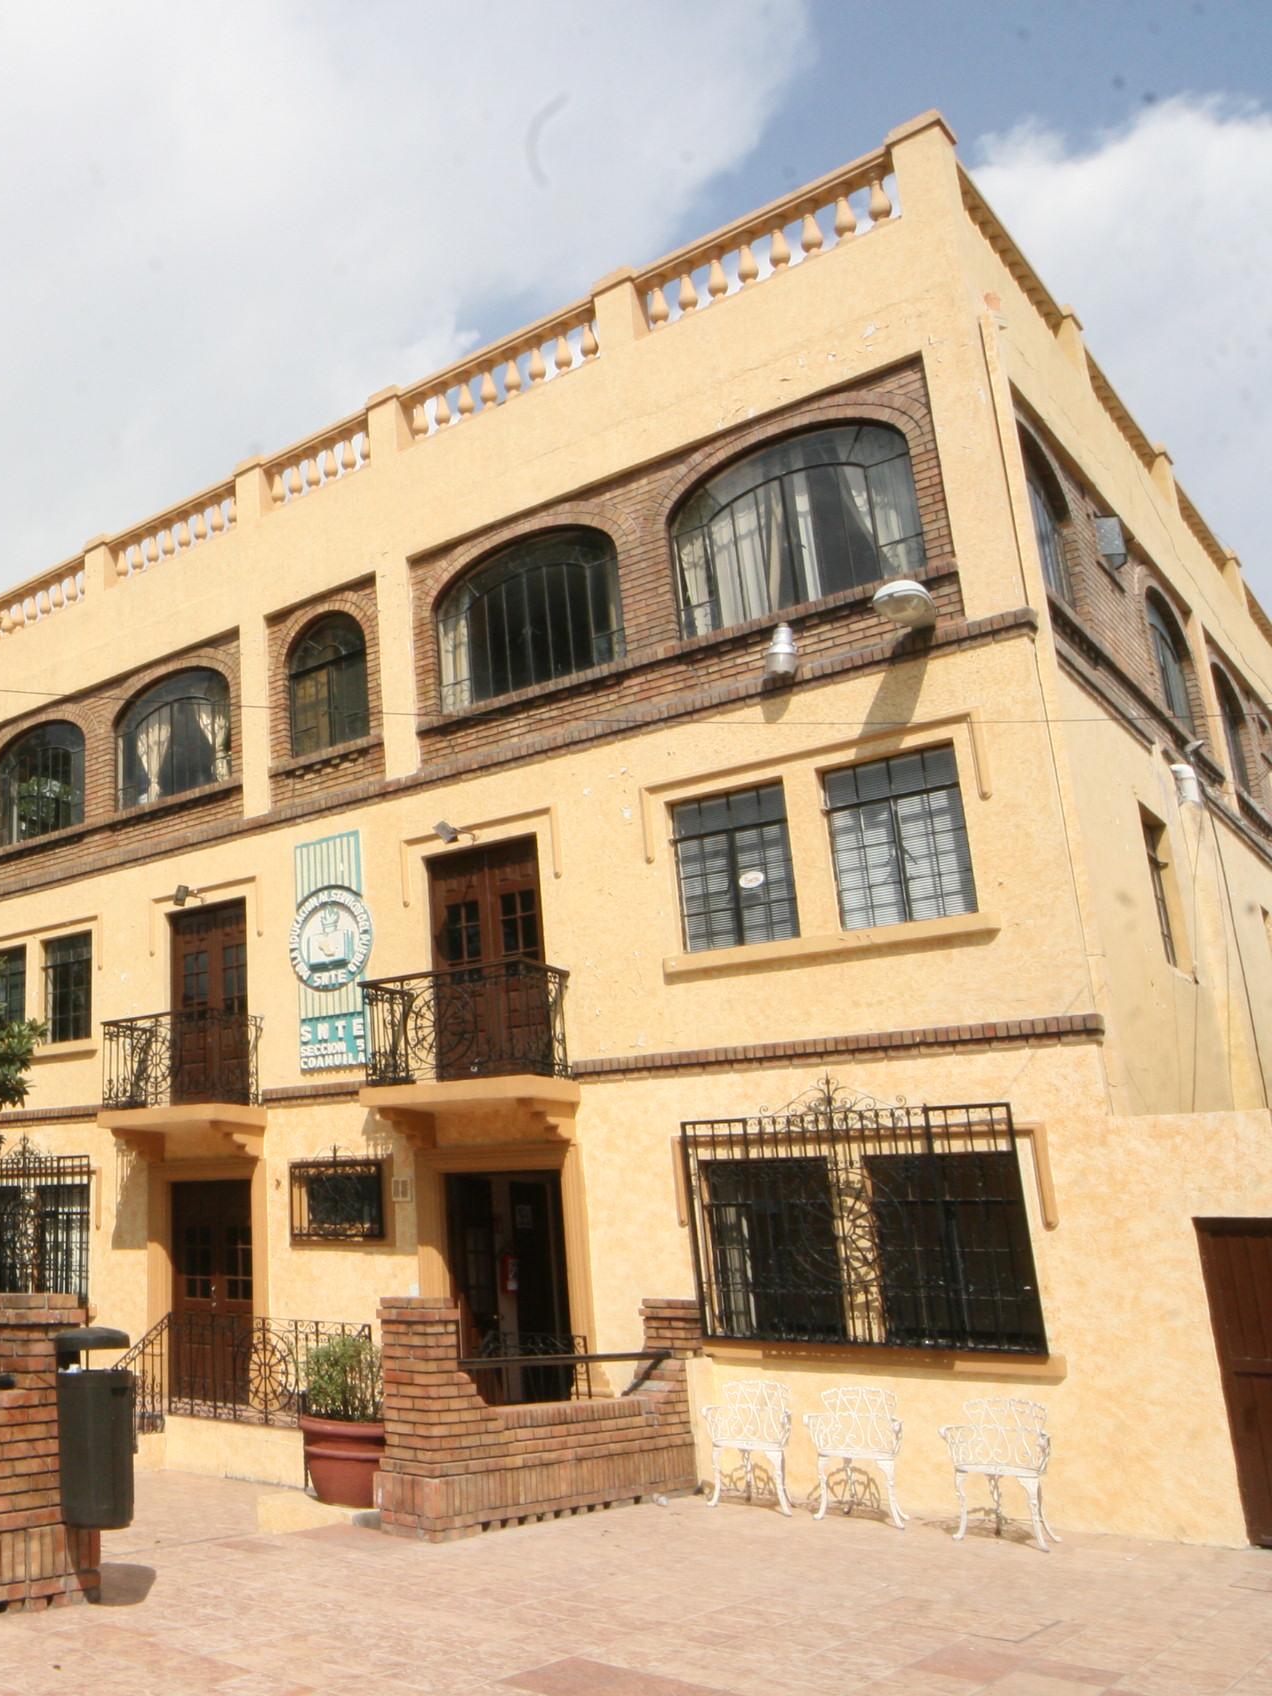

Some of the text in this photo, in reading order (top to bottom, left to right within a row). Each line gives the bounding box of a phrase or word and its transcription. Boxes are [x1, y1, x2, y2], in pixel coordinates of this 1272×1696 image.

[317, 890, 329, 903] AL
[289, 896, 320, 949] EDUCACION
[357, 914, 370, 933] DEL
[348, 933, 371, 973] PUEBLO
[313, 970, 347, 987] SNTE
[300, 1018, 364, 1042] SNTE
[300, 1039, 365, 1057] SECCION 5
[300, 1051, 366, 1070] COAHUILA
